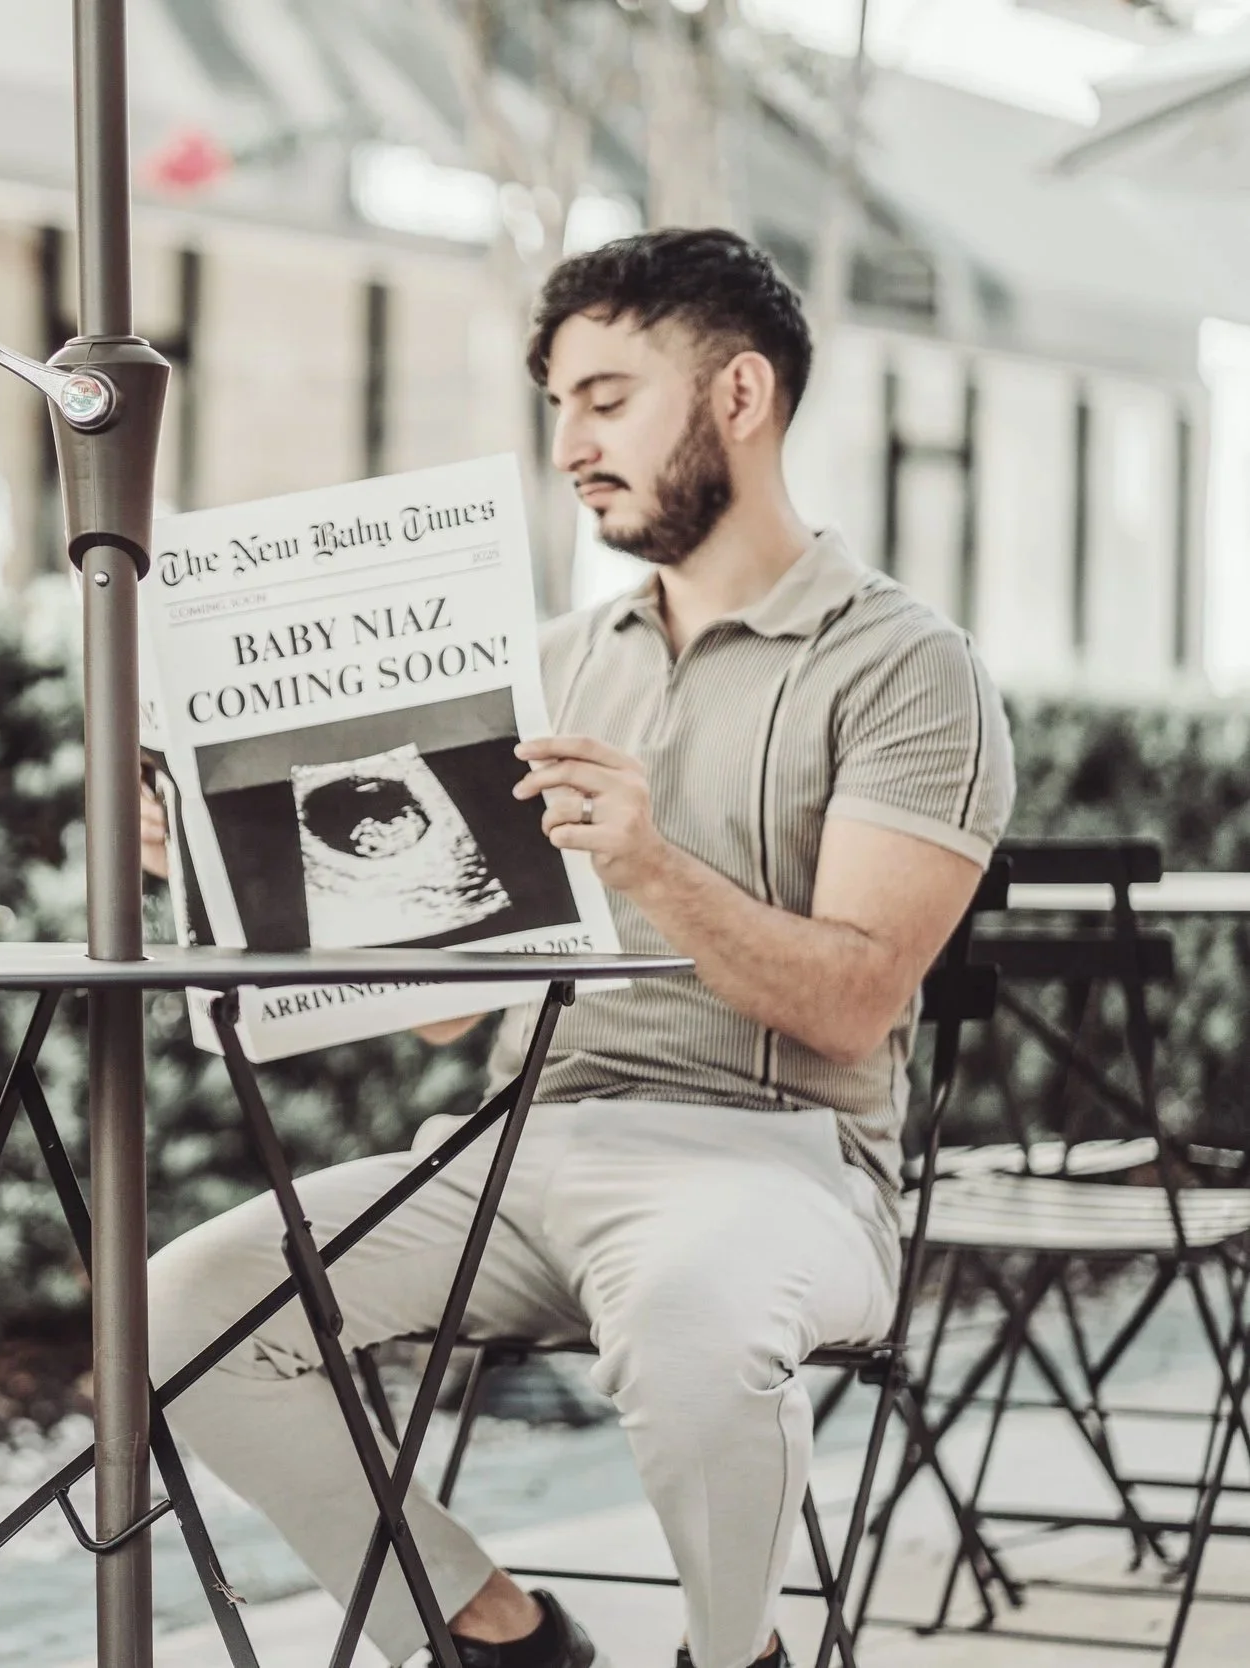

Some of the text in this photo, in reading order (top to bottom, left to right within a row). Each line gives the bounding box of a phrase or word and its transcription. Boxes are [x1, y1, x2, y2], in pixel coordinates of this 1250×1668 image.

[158, 499, 496, 586] The New Baby Times
[233, 596, 452, 666] BABY NIAZ
[187, 664, 364, 723] COMING
[377, 635, 509, 690] SOON!
[261, 981, 384, 1021] ARRIVING
